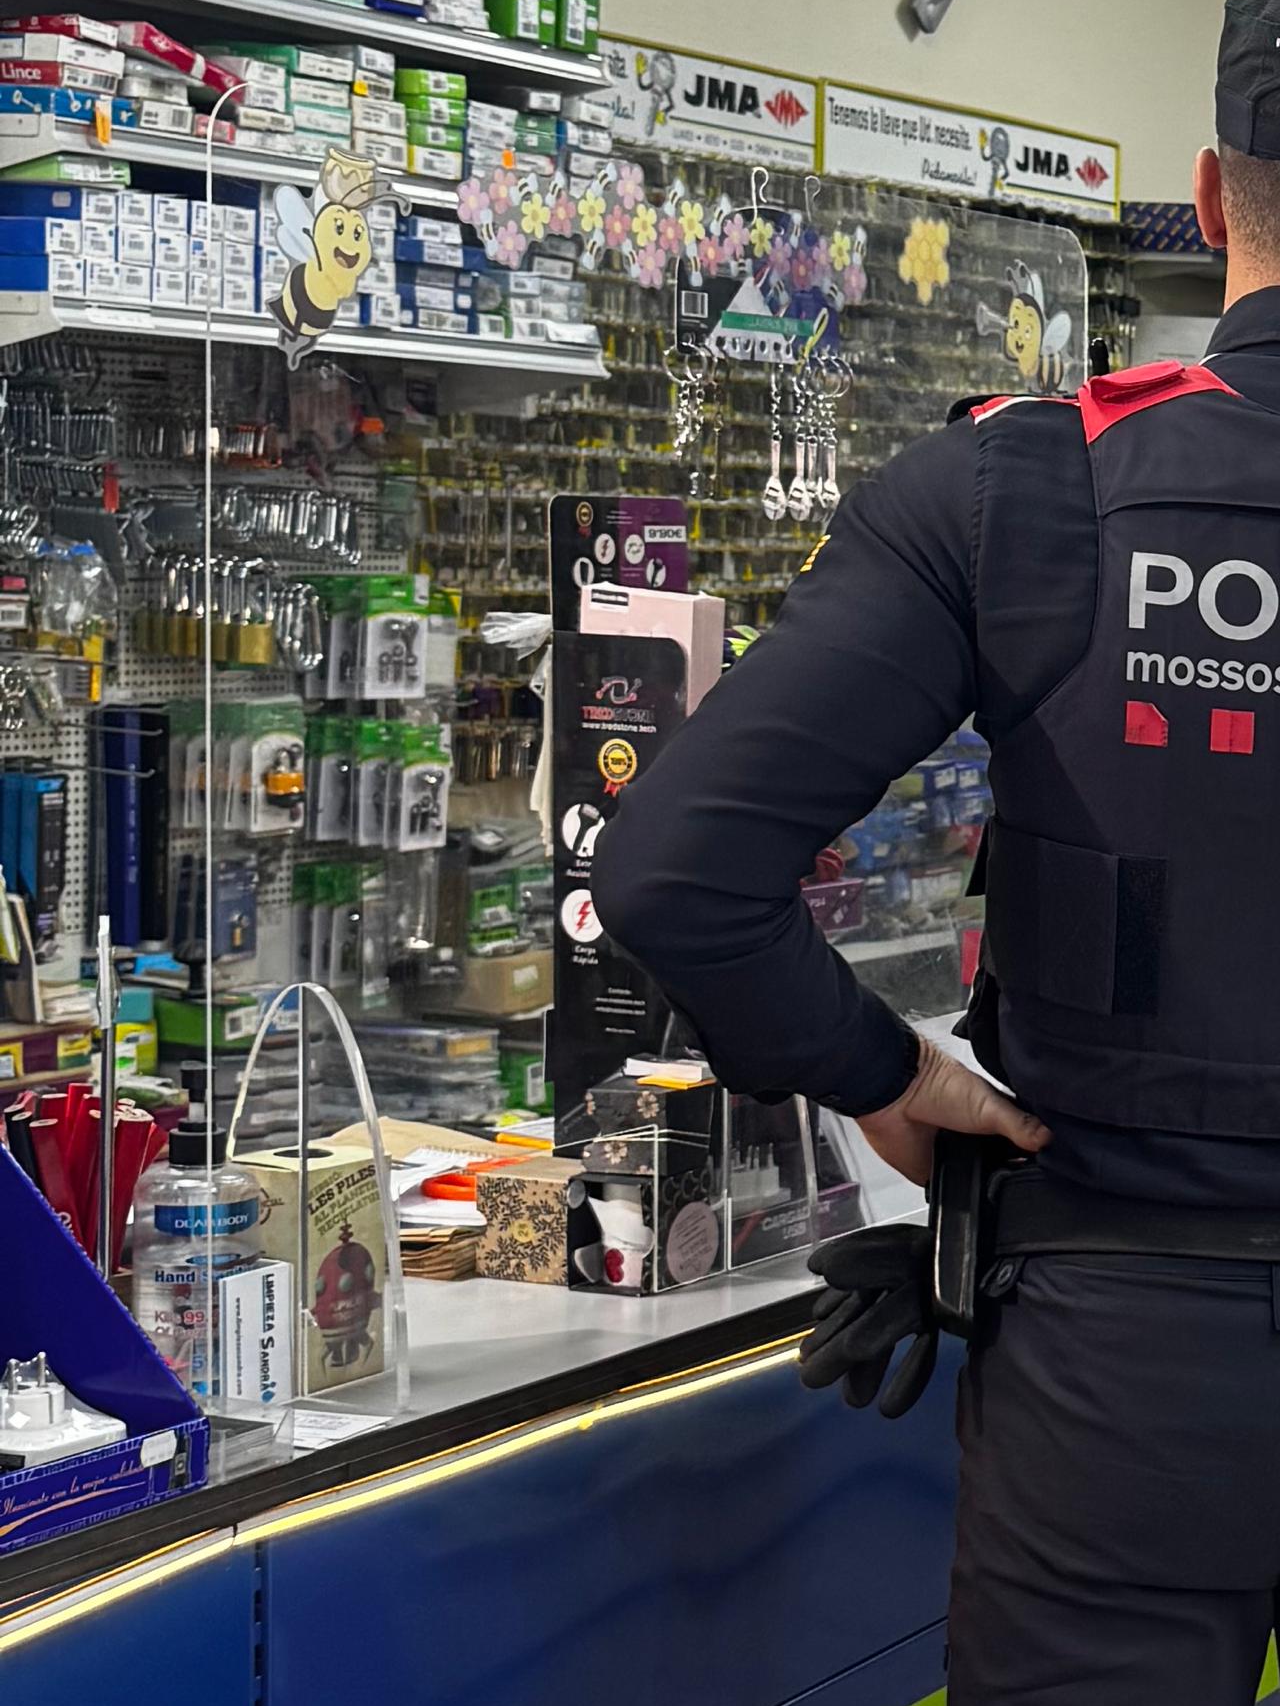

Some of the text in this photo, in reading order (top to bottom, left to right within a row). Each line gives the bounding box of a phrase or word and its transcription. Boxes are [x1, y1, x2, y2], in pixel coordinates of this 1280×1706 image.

[2, 64, 42, 80] Lince
[684, 74, 761, 119] JMA
[1016, 145, 1073, 182] JMA
[308, 1188, 335, 1215] LES
[336, 1164, 377, 1195] PILES
[154, 1271, 196, 1283] Hand
[264, 1272, 275, 1332] LIMPIEZA
